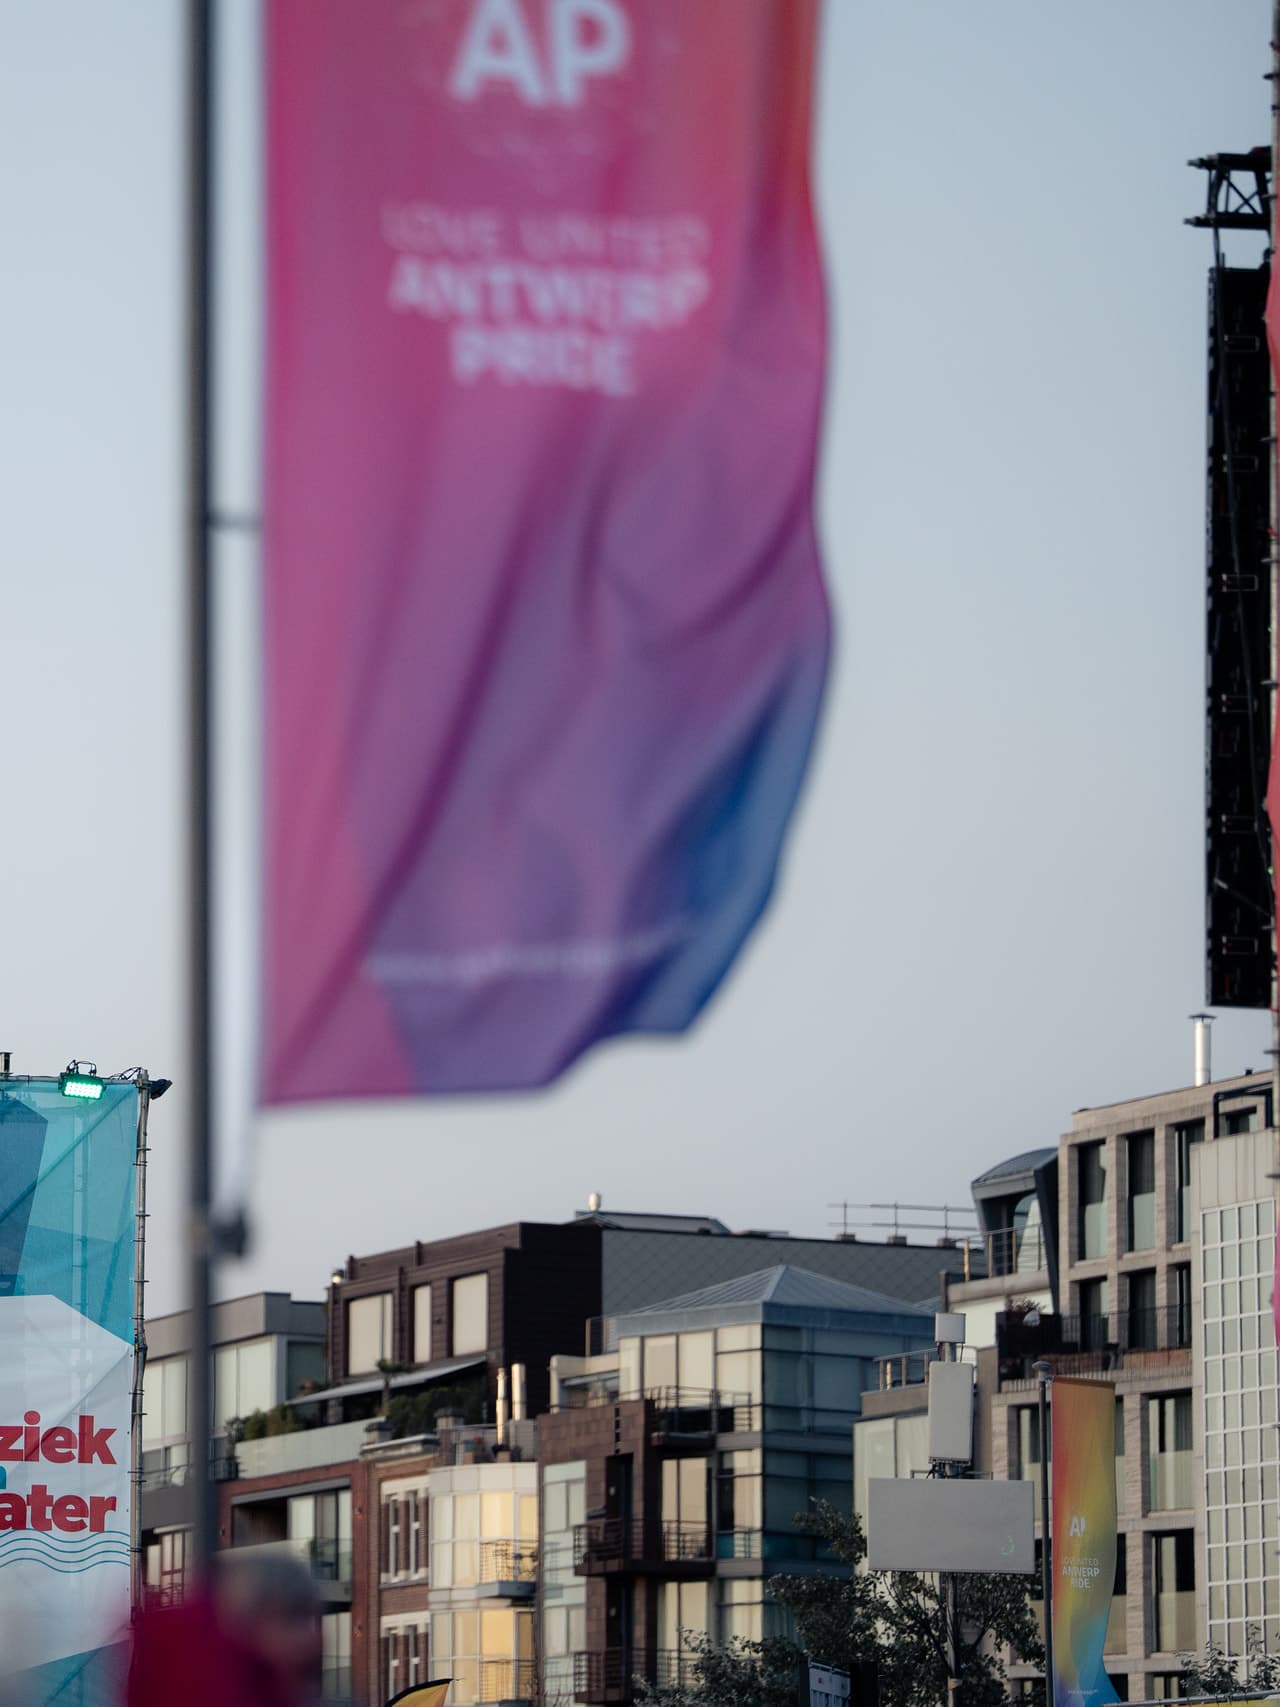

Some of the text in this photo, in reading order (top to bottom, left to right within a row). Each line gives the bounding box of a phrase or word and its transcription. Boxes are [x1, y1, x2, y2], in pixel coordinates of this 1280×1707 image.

[450, 0, 632, 106] AP
[389, 256, 710, 330] ANTWERP
[450, 328, 635, 396] PRIDE
